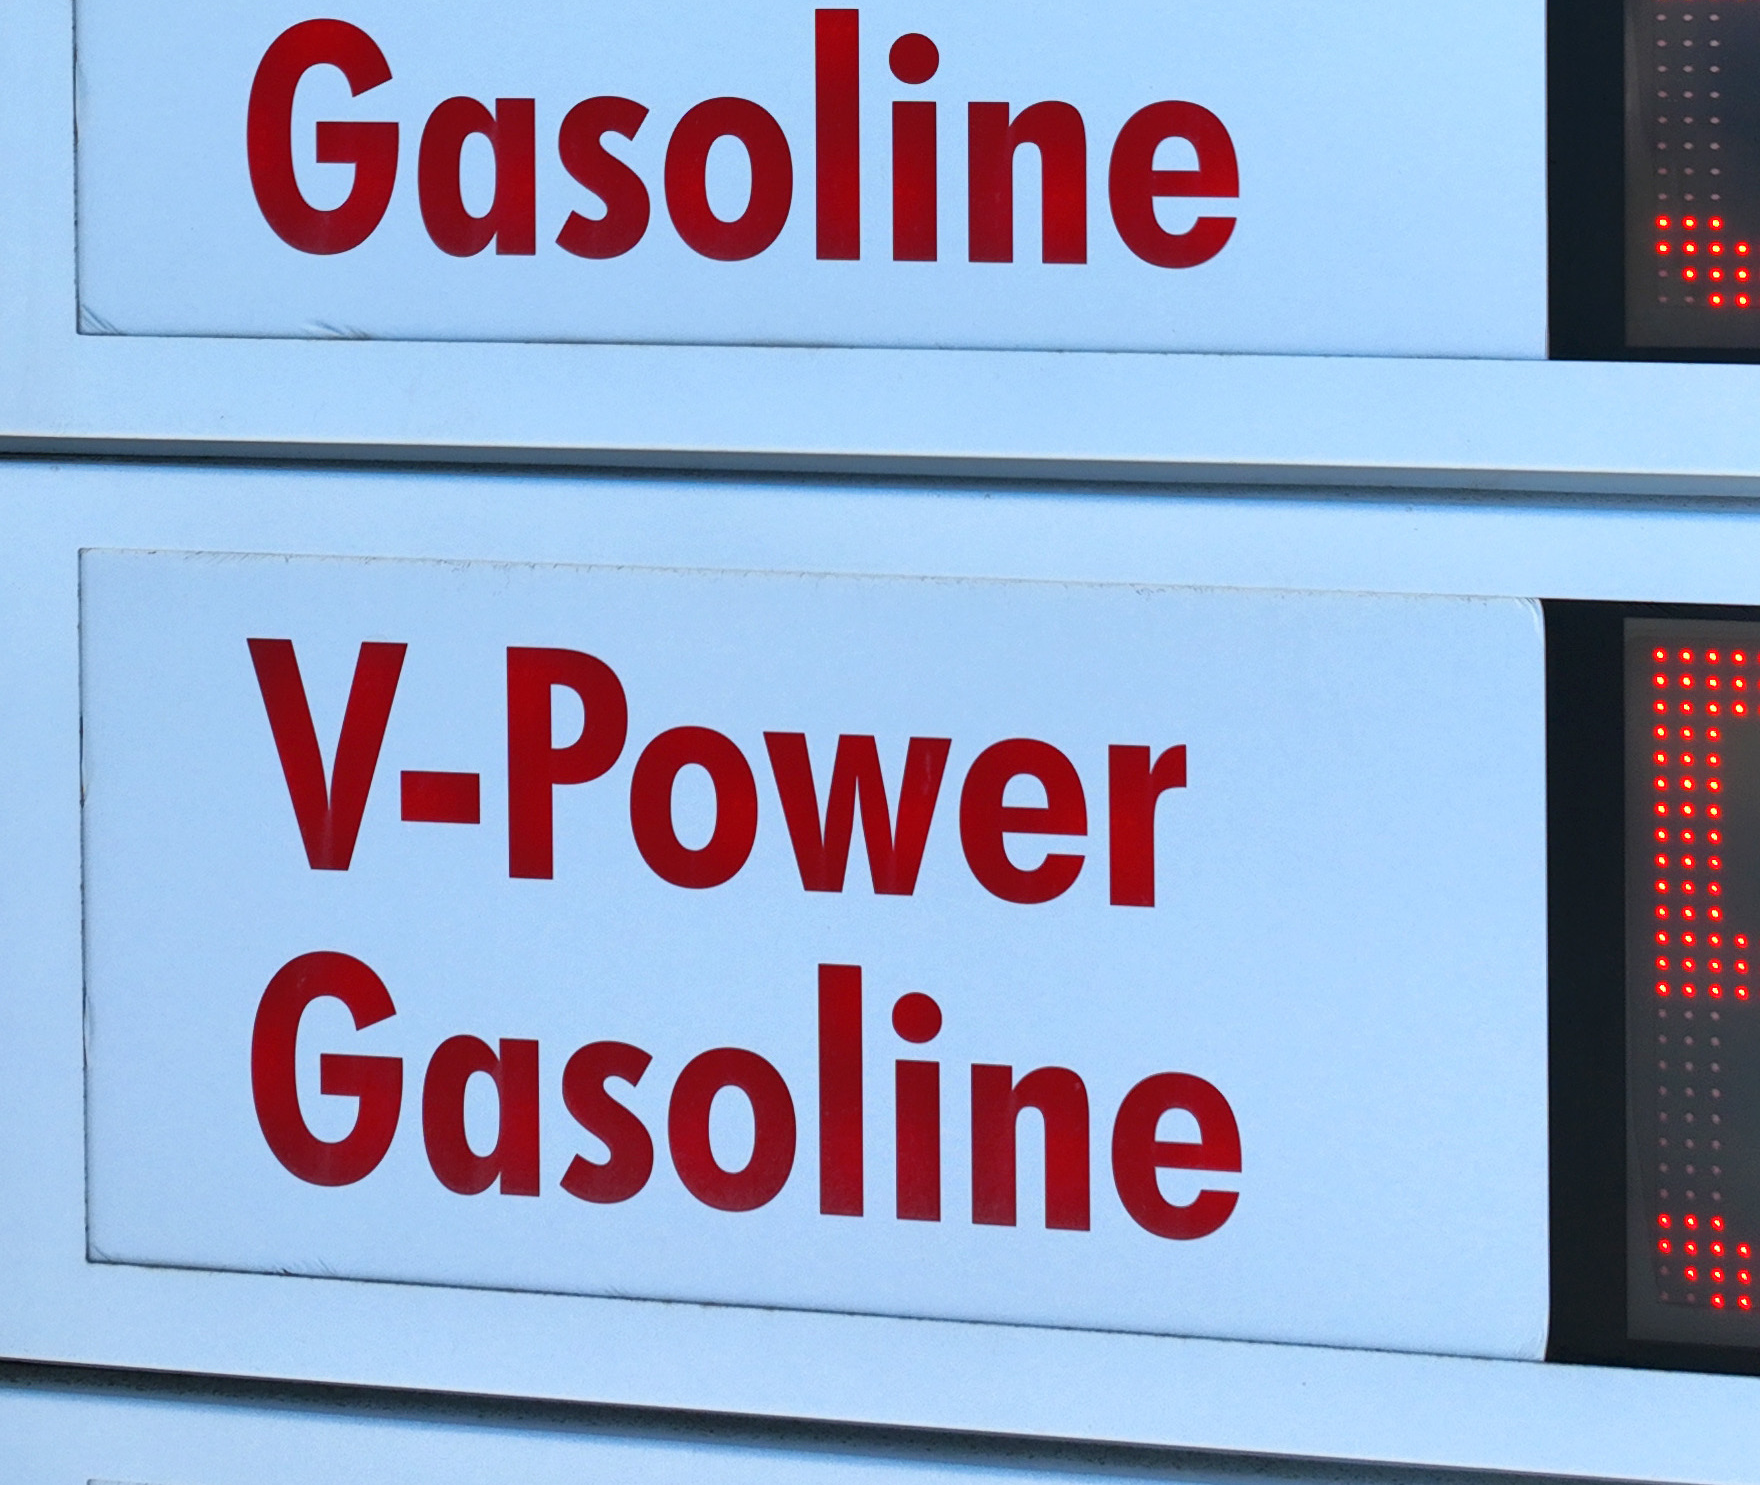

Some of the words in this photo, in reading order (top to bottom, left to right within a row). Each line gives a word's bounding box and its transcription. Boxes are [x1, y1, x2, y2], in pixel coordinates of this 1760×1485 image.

[247, 9, 1240, 268] Gasoline
[250, 639, 1187, 908] V-Power
[252, 953, 1242, 1240] Gasoline
